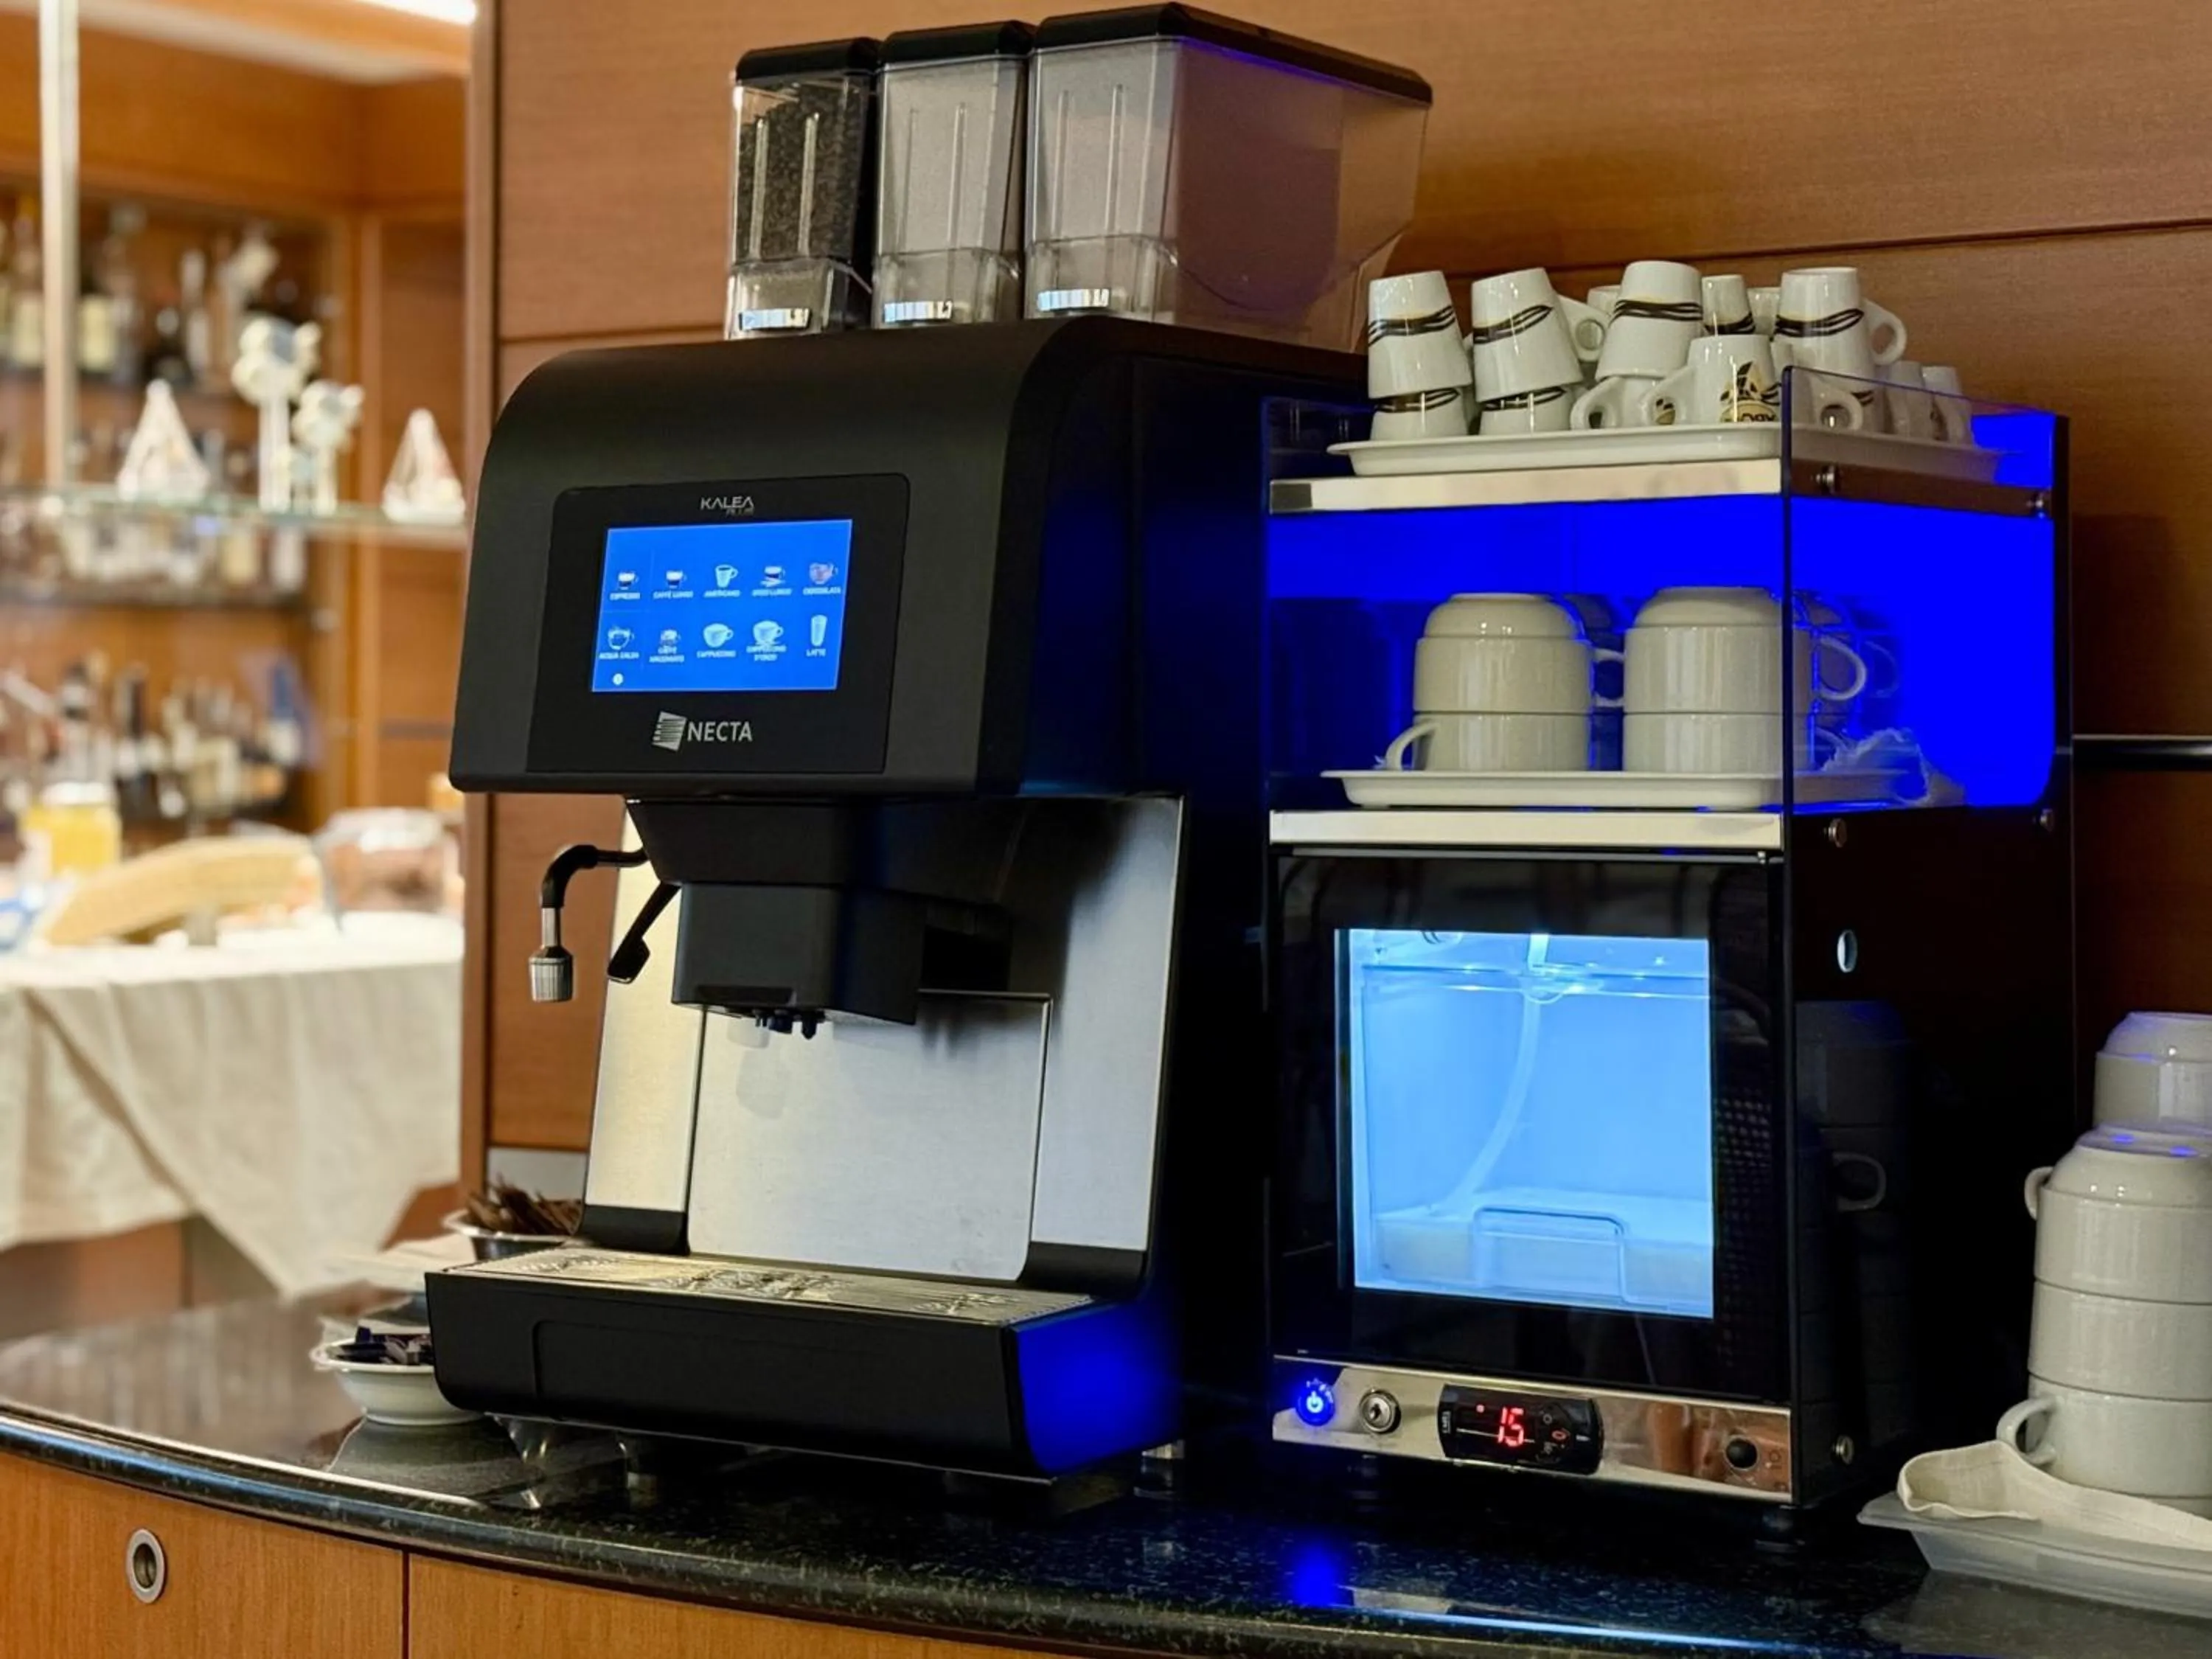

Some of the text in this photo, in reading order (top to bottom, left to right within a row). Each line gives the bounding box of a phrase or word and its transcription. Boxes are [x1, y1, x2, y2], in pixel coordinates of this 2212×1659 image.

[700, 496, 754, 510] KALEA
[686, 721, 753, 742] NECTA
[1498, 1407, 1524, 1447] 15
